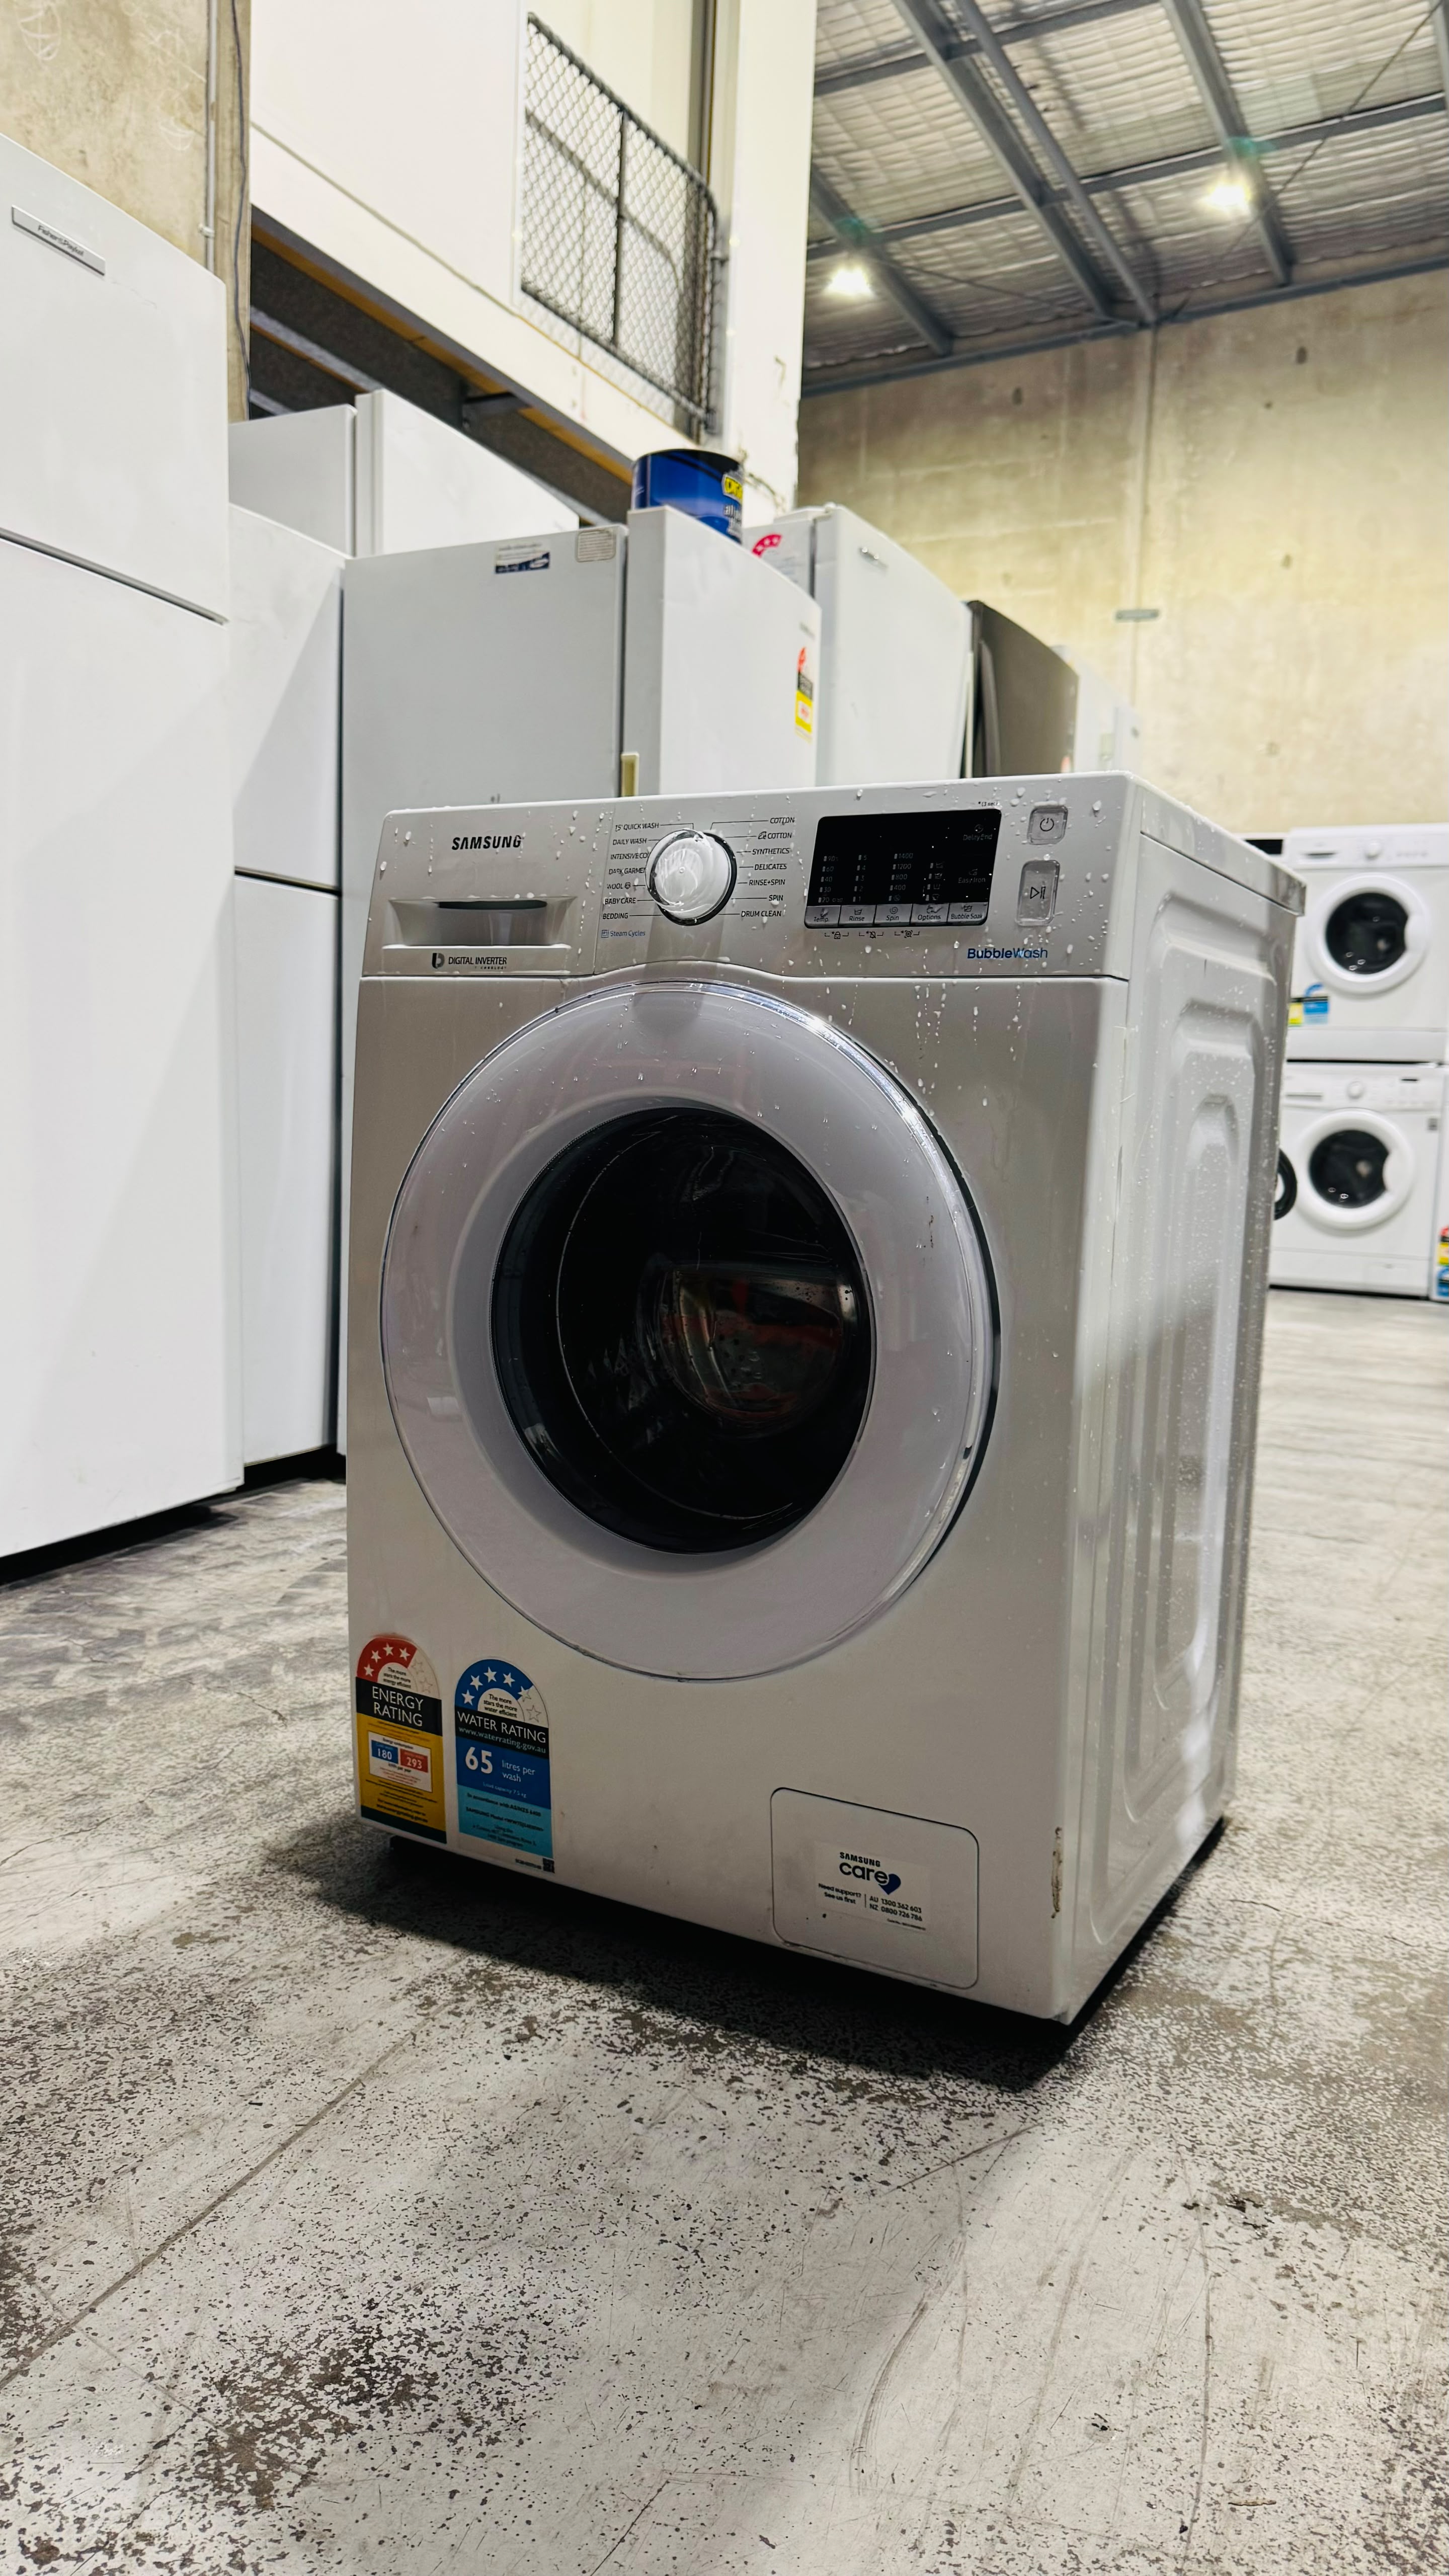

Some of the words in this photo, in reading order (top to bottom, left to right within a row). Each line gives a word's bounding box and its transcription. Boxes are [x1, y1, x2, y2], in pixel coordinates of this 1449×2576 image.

[452, 835, 522, 850] SAMSUNG
[448, 956, 474, 965] DIGITAL
[475, 956, 507, 965] INVERTER
[967, 948, 1048, 958] BubbleWash
[372, 1686, 424, 1711] ENERGY
[374, 1702, 423, 1727] RATING
[457, 1711, 498, 1731] WATER
[501, 1722, 546, 1743] RATING
[458, 1726, 546, 1754] www.waterrating.gov.au
[377, 1748, 392, 1760] 180
[465, 1746, 493, 1774] 65
[406, 1756, 423, 1769] 293
[502, 1759, 520, 1772] litres
[523, 1766, 535, 1776] per
[502, 1772, 521, 1783] wash
[840, 1852, 880, 1867] SAMSUNG
[839, 1862, 888, 1884] care
[818, 1883, 834, 1892] Need
[835, 1887, 861, 1898] support?
[844, 1896, 856, 1904] first
[881, 1898, 896, 1907] 1300
[897, 1902, 909, 1910] 362
[910, 1905, 922, 1913] 603
[881, 1906, 898, 1915] 0800
[899, 1910, 910, 1918] 726
[911, 1913, 923, 1921] 786
